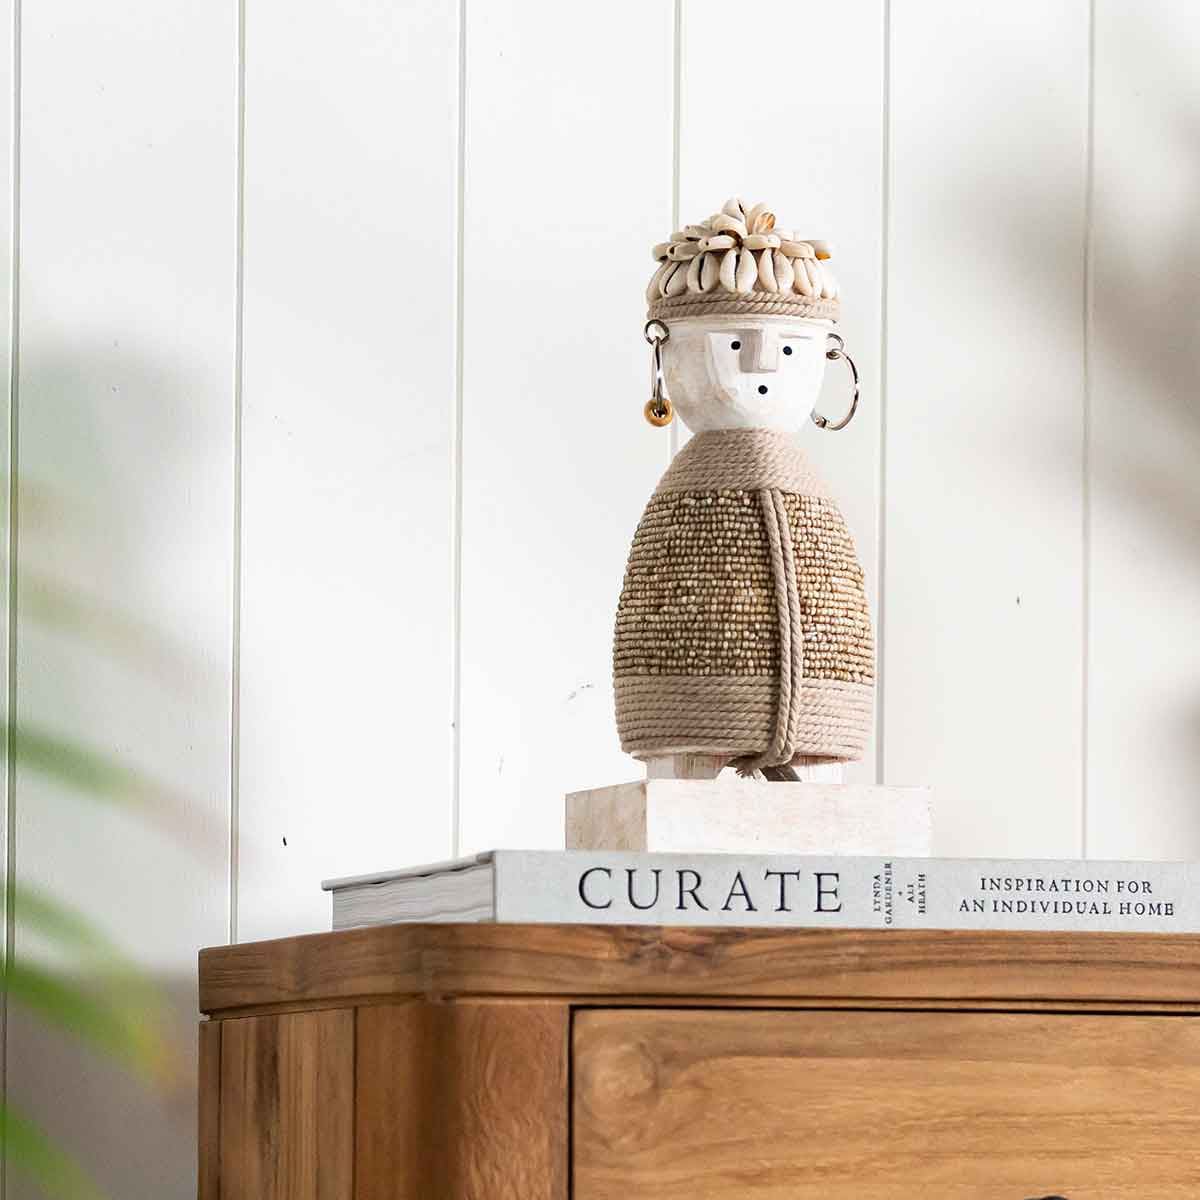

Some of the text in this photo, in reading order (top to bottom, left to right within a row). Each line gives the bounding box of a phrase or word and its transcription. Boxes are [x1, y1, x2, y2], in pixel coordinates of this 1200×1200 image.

[578, 866, 842, 913] CURATE
[873, 873, 881, 912] LYNDA
[884, 862, 893, 925] GARDENER
[918, 873, 926, 914] HEATH
[980, 877, 1153, 894] INSPIRATION FOR
[959, 899, 1174, 916] AN INDIVIDUAL HOME
